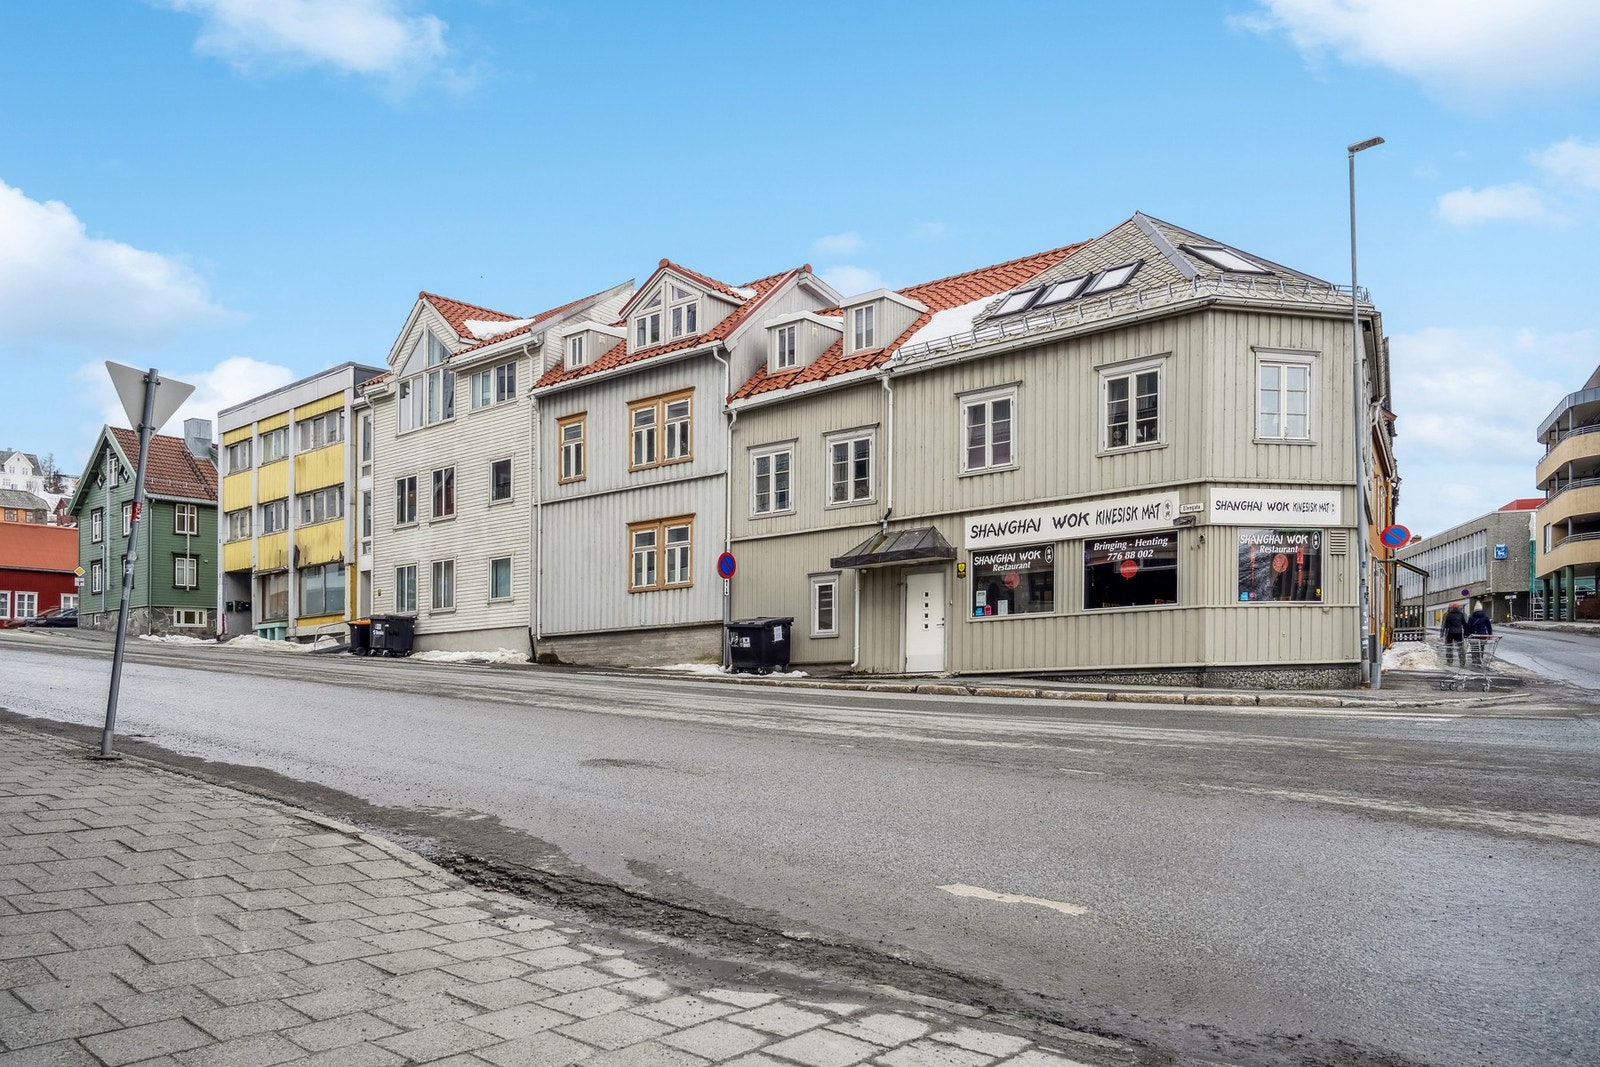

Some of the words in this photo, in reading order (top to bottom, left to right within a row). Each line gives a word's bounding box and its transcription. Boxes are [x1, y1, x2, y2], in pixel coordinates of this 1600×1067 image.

[1215, 500, 1263, 511] SHANGHAI
[1267, 502, 1290, 512] WOK
[1293, 503, 1318, 513] KINESISK
[1318, 503, 1330, 513] MAT
[970, 517, 1042, 539] SHANGHAI
[1052, 512, 1090, 530] WOK
[1096, 506, 1138, 525] KINESISK
[1141, 502, 1162, 520] MAT
[1094, 542, 1128, 552] Bringing
[1135, 537, 1169, 547] Henting
[1239, 534, 1283, 544] SHANGHAI
[1287, 535, 1308, 544] WOK
[1107, 552, 1123, 561] 776
[1125, 551, 1136, 559] 88
[1138, 550, 1154, 558] 002
[1259, 545, 1298, 554] Restaurant
[974, 553, 1016, 566] SHANGHAI
[1019, 550, 1042, 561] WOK
[992, 561, 1031, 572] Restaurant
